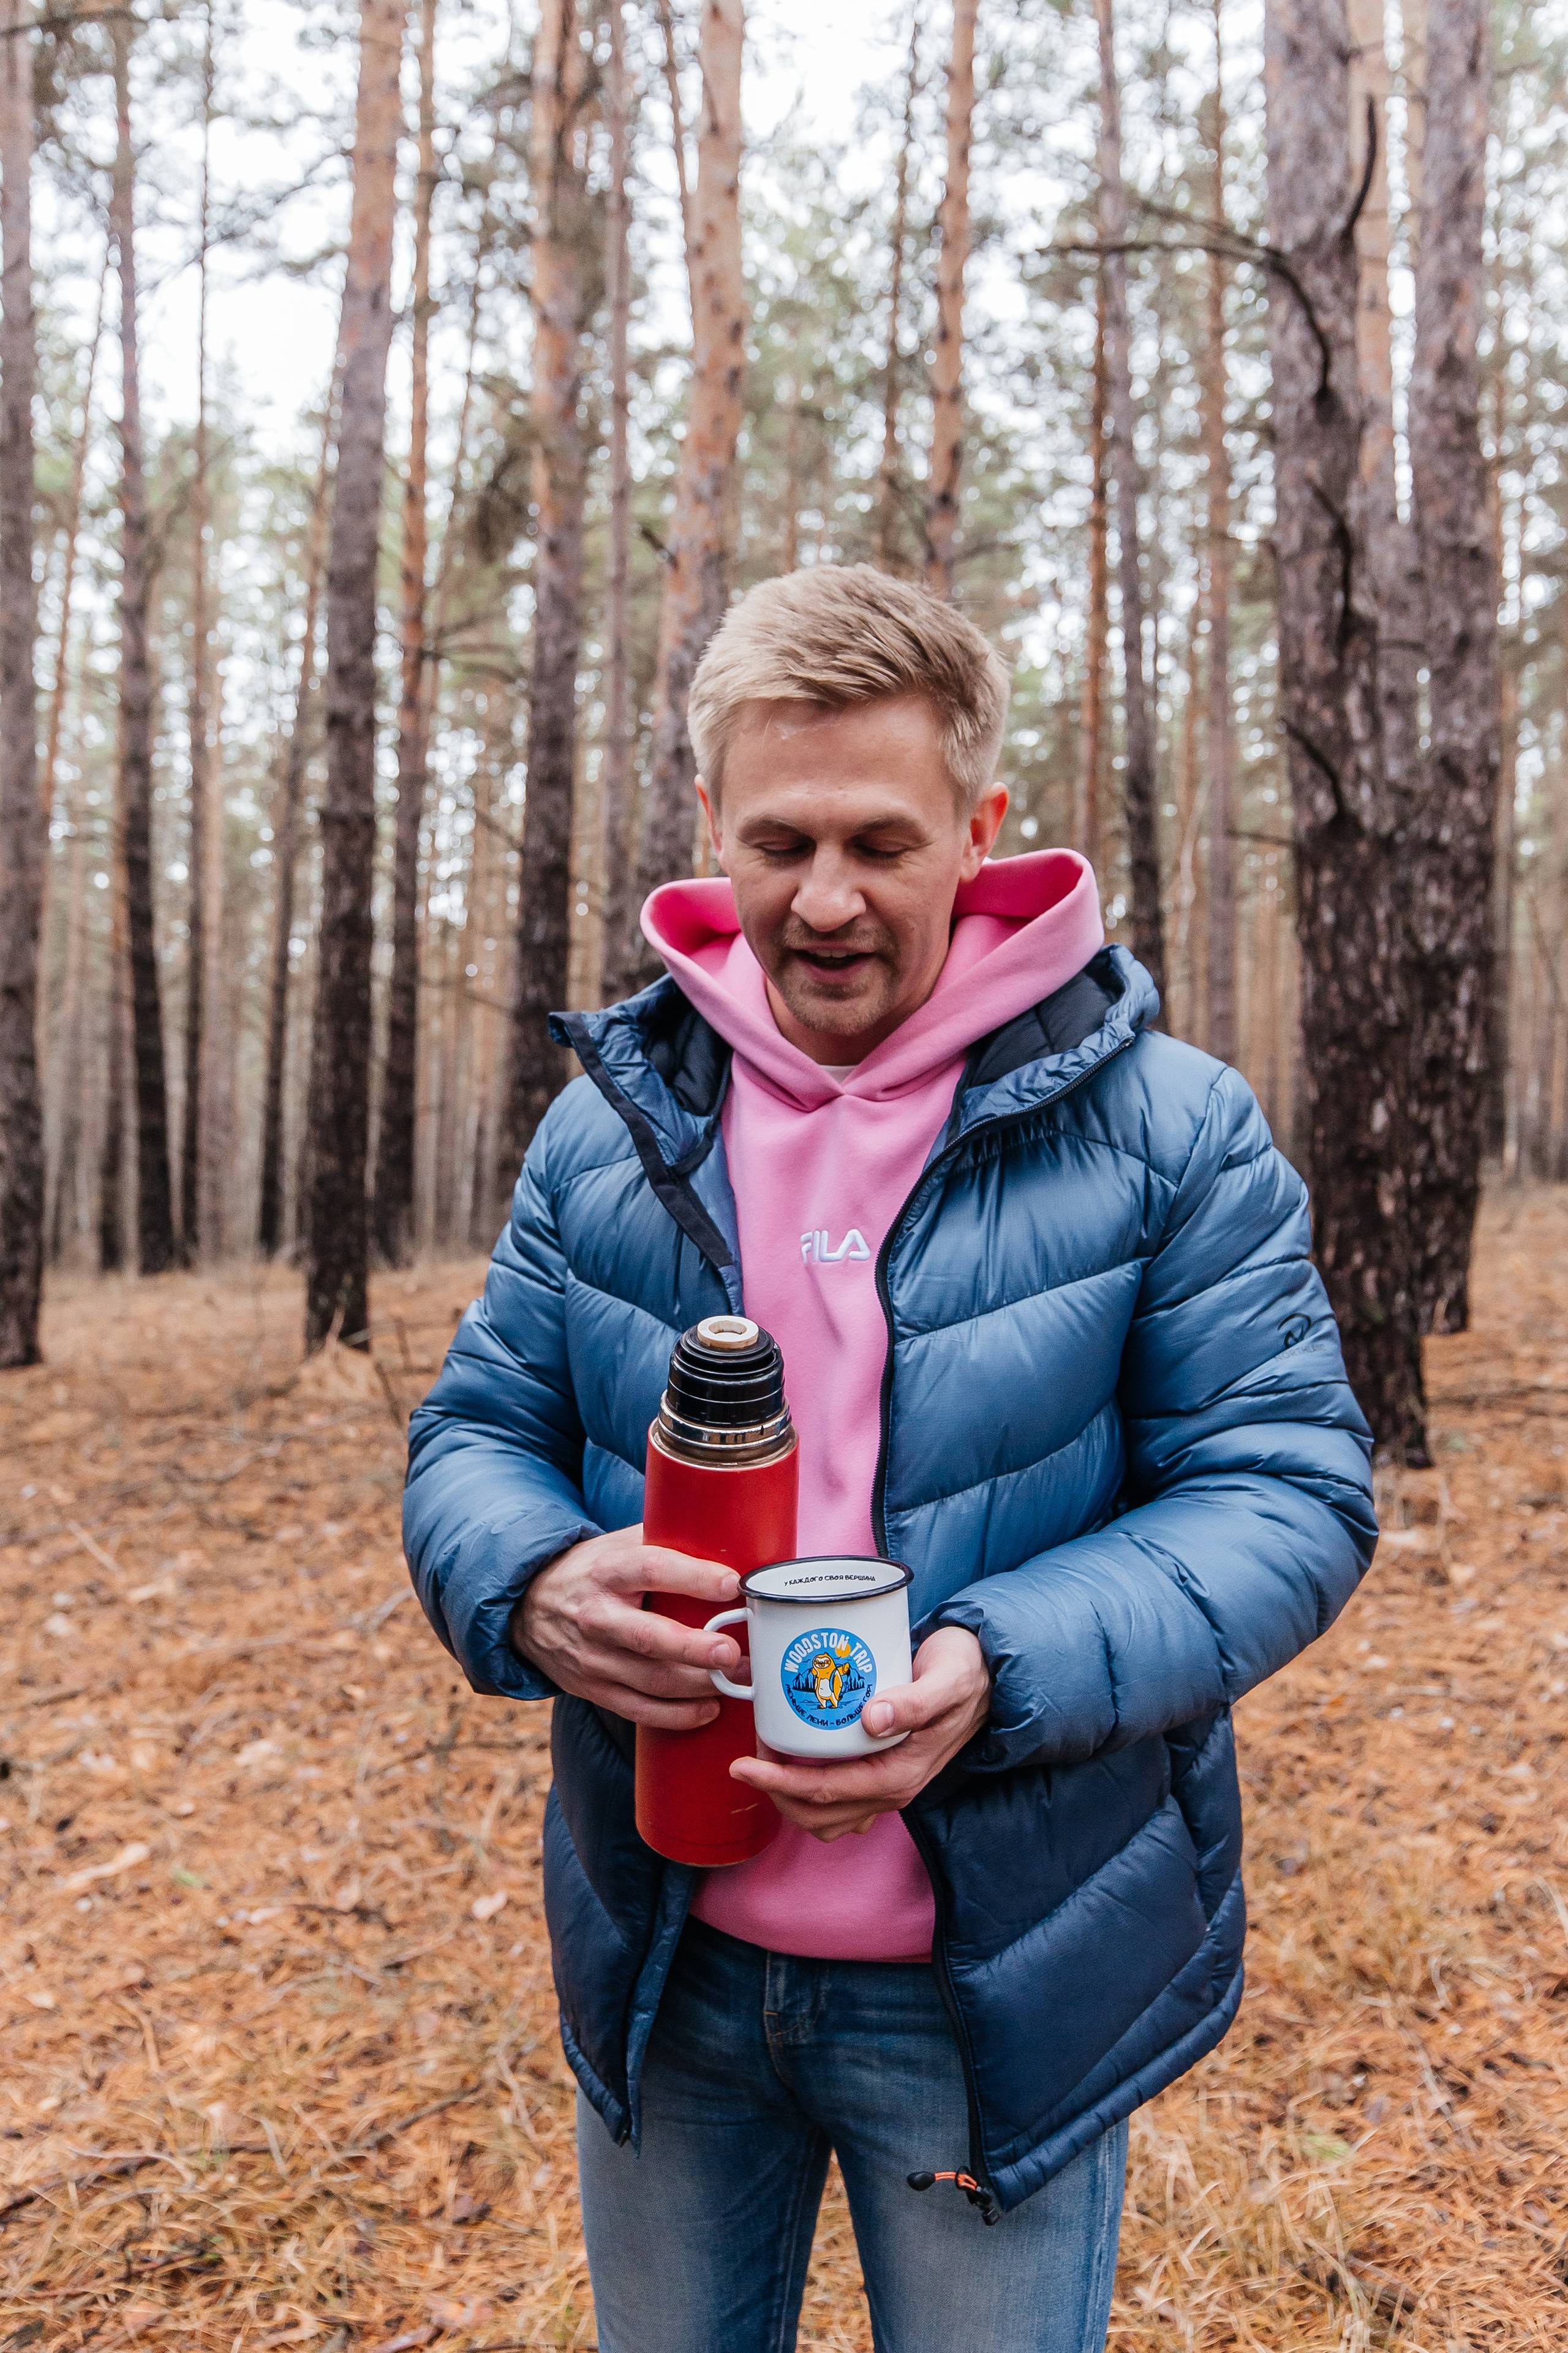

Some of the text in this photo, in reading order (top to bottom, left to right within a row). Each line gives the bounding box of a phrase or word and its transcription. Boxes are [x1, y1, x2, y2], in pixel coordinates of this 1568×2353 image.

[800, 1228, 870, 1265] FILA
[789, 1576, 823, 1585] КАЖДОГО
[784, 1632, 873, 1674] WOODSTON TRIP
[785, 1683, 807, 1717] МЕНЬШЕ
[806, 1714, 829, 1727] ЛЕНИ
[835, 1702, 864, 1726] БОЛЬШЕ
